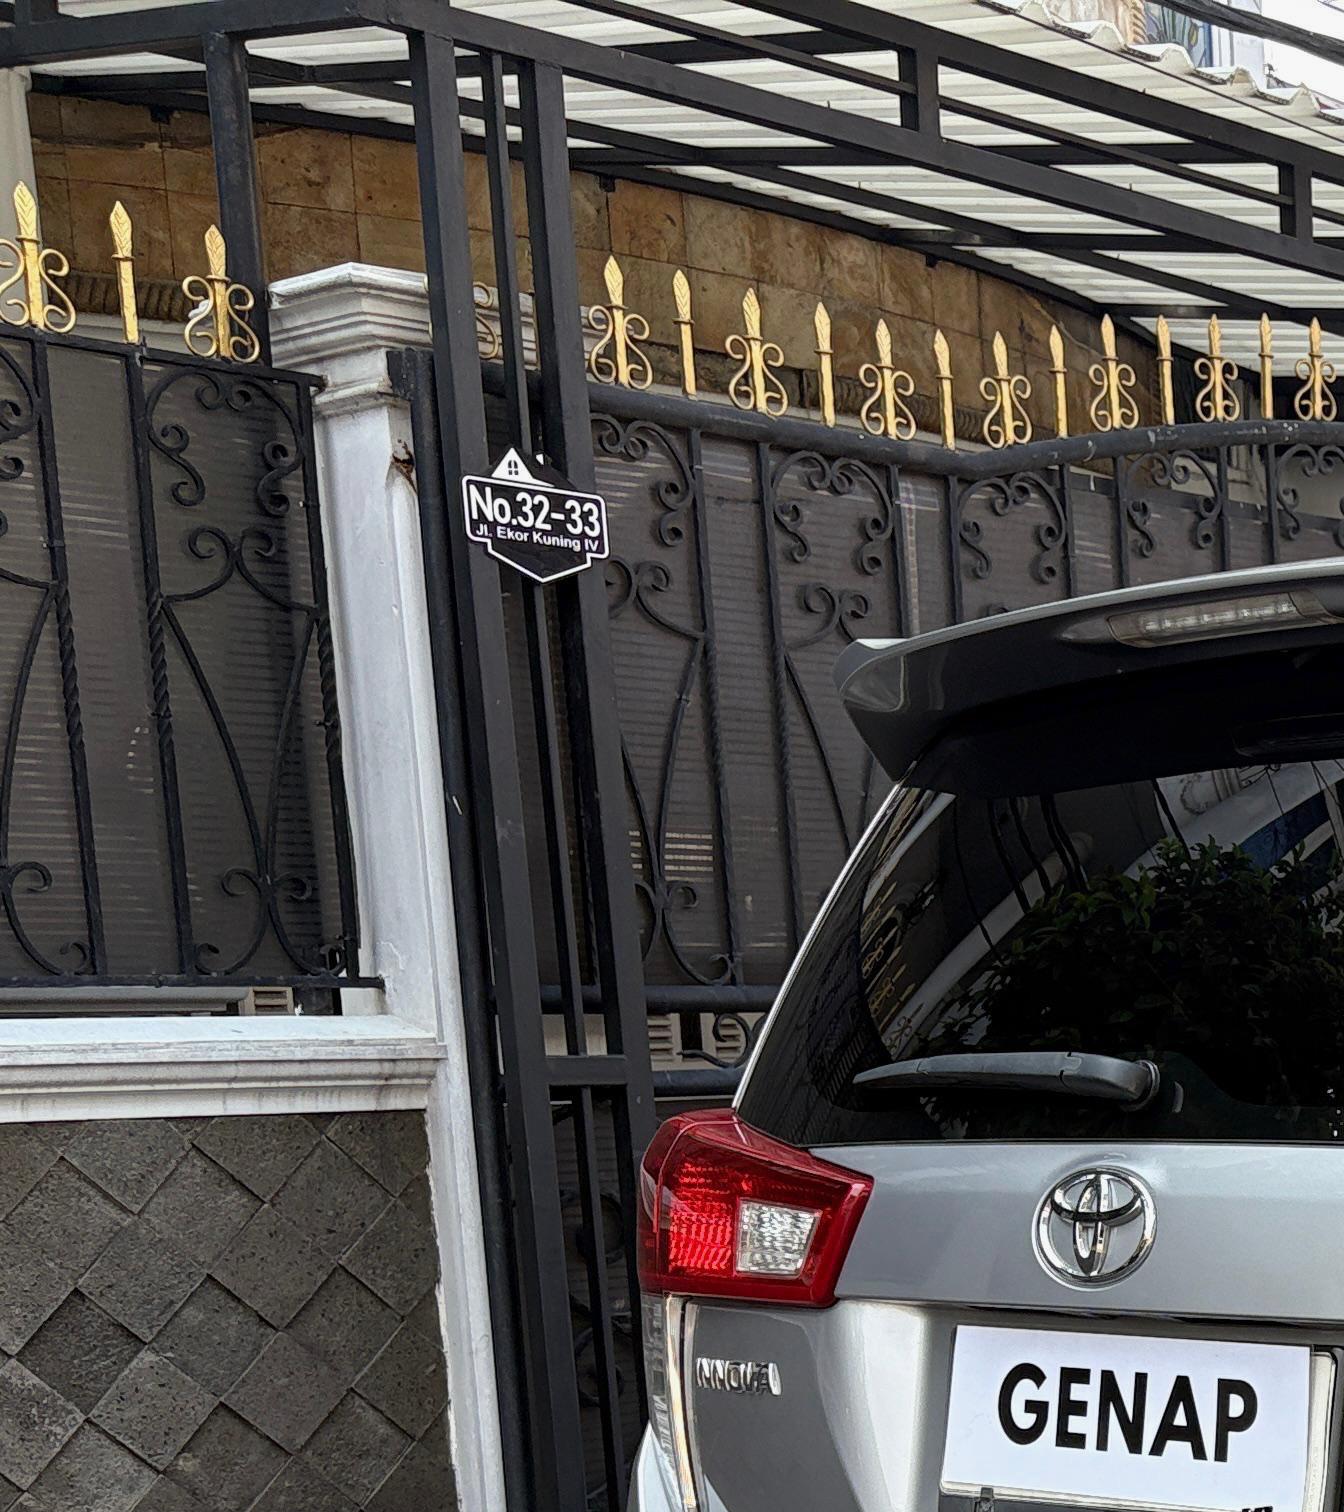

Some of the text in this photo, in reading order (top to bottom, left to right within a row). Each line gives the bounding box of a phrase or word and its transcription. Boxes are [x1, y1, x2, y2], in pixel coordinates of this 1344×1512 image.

[469, 484, 601, 537] No.32-33
[497, 526, 529, 543] Ekor
[532, 531, 581, 551] Kuning
[584, 538, 600, 552] IV
[997, 1361, 1259, 1463] GENAP
